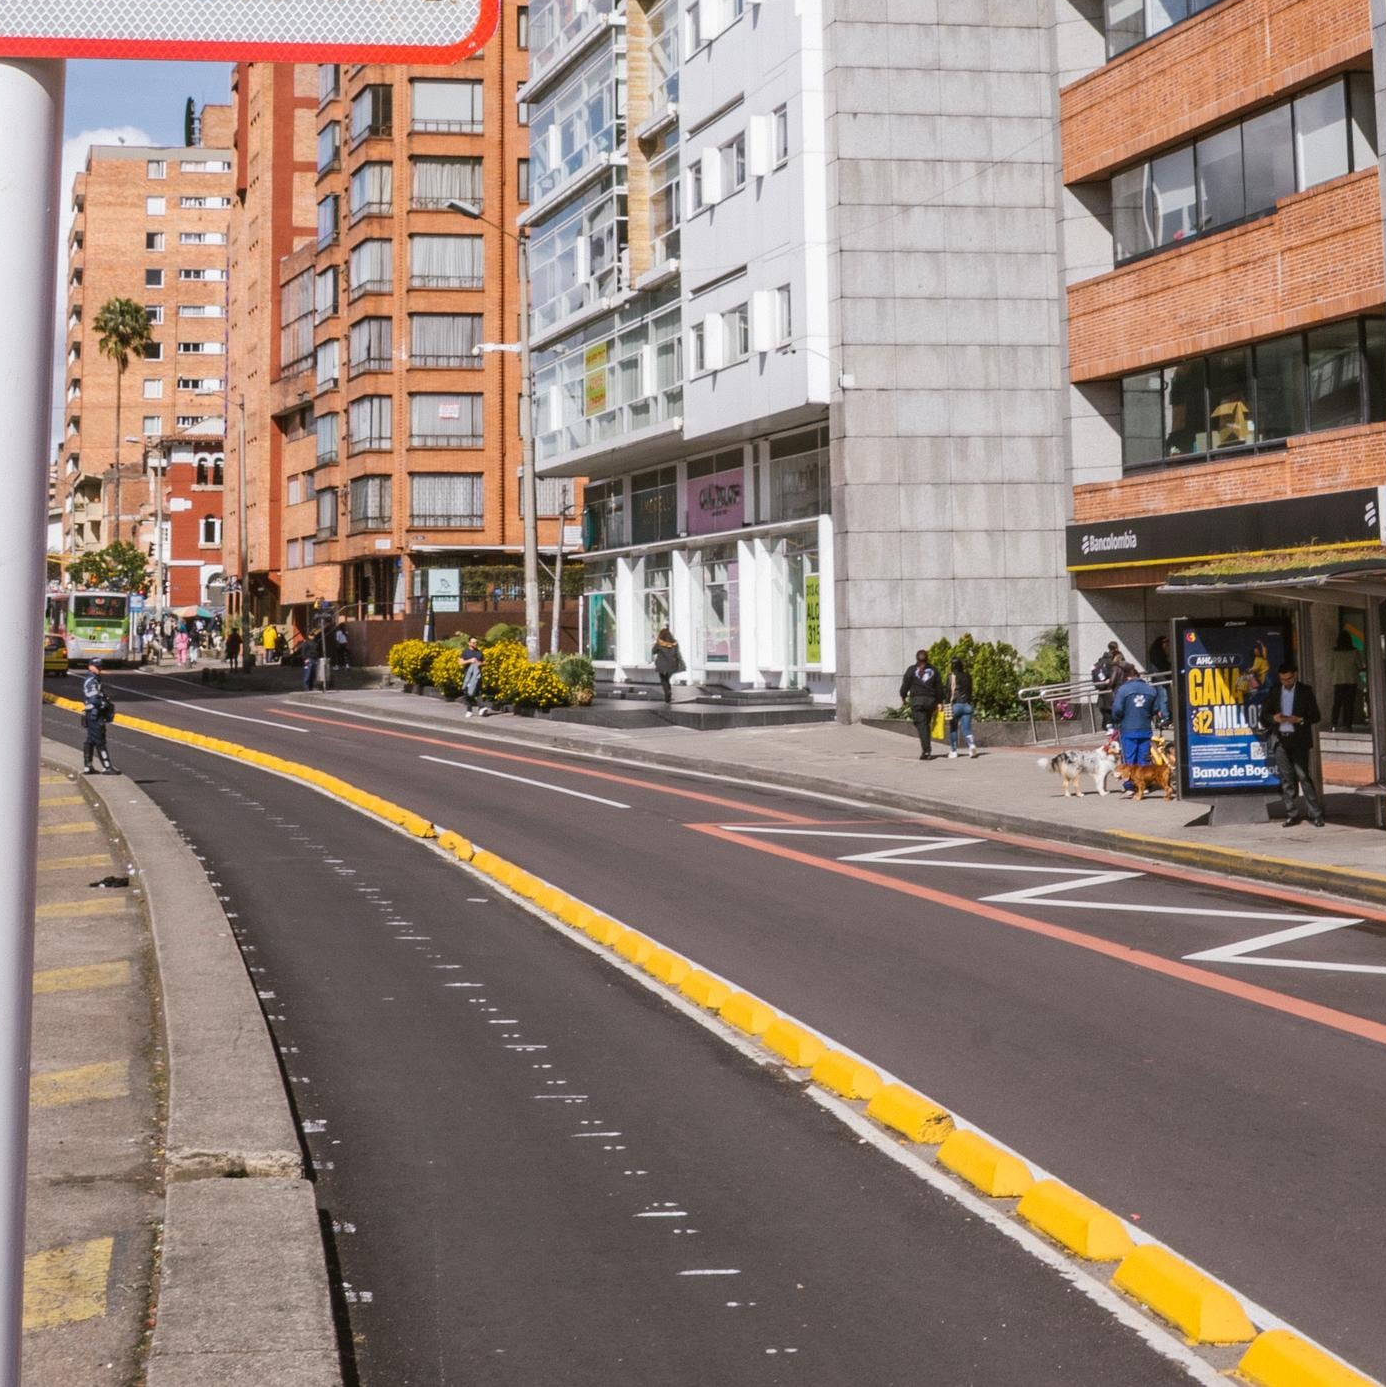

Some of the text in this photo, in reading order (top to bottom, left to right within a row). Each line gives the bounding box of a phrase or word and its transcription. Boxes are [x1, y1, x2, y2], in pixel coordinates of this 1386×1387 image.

[1089, 529, 1138, 552] Bancolombia
[1188, 667, 1245, 706] GANA
[1192, 709, 1213, 734] $12
[1192, 763, 1281, 779] Banco de Bogot
